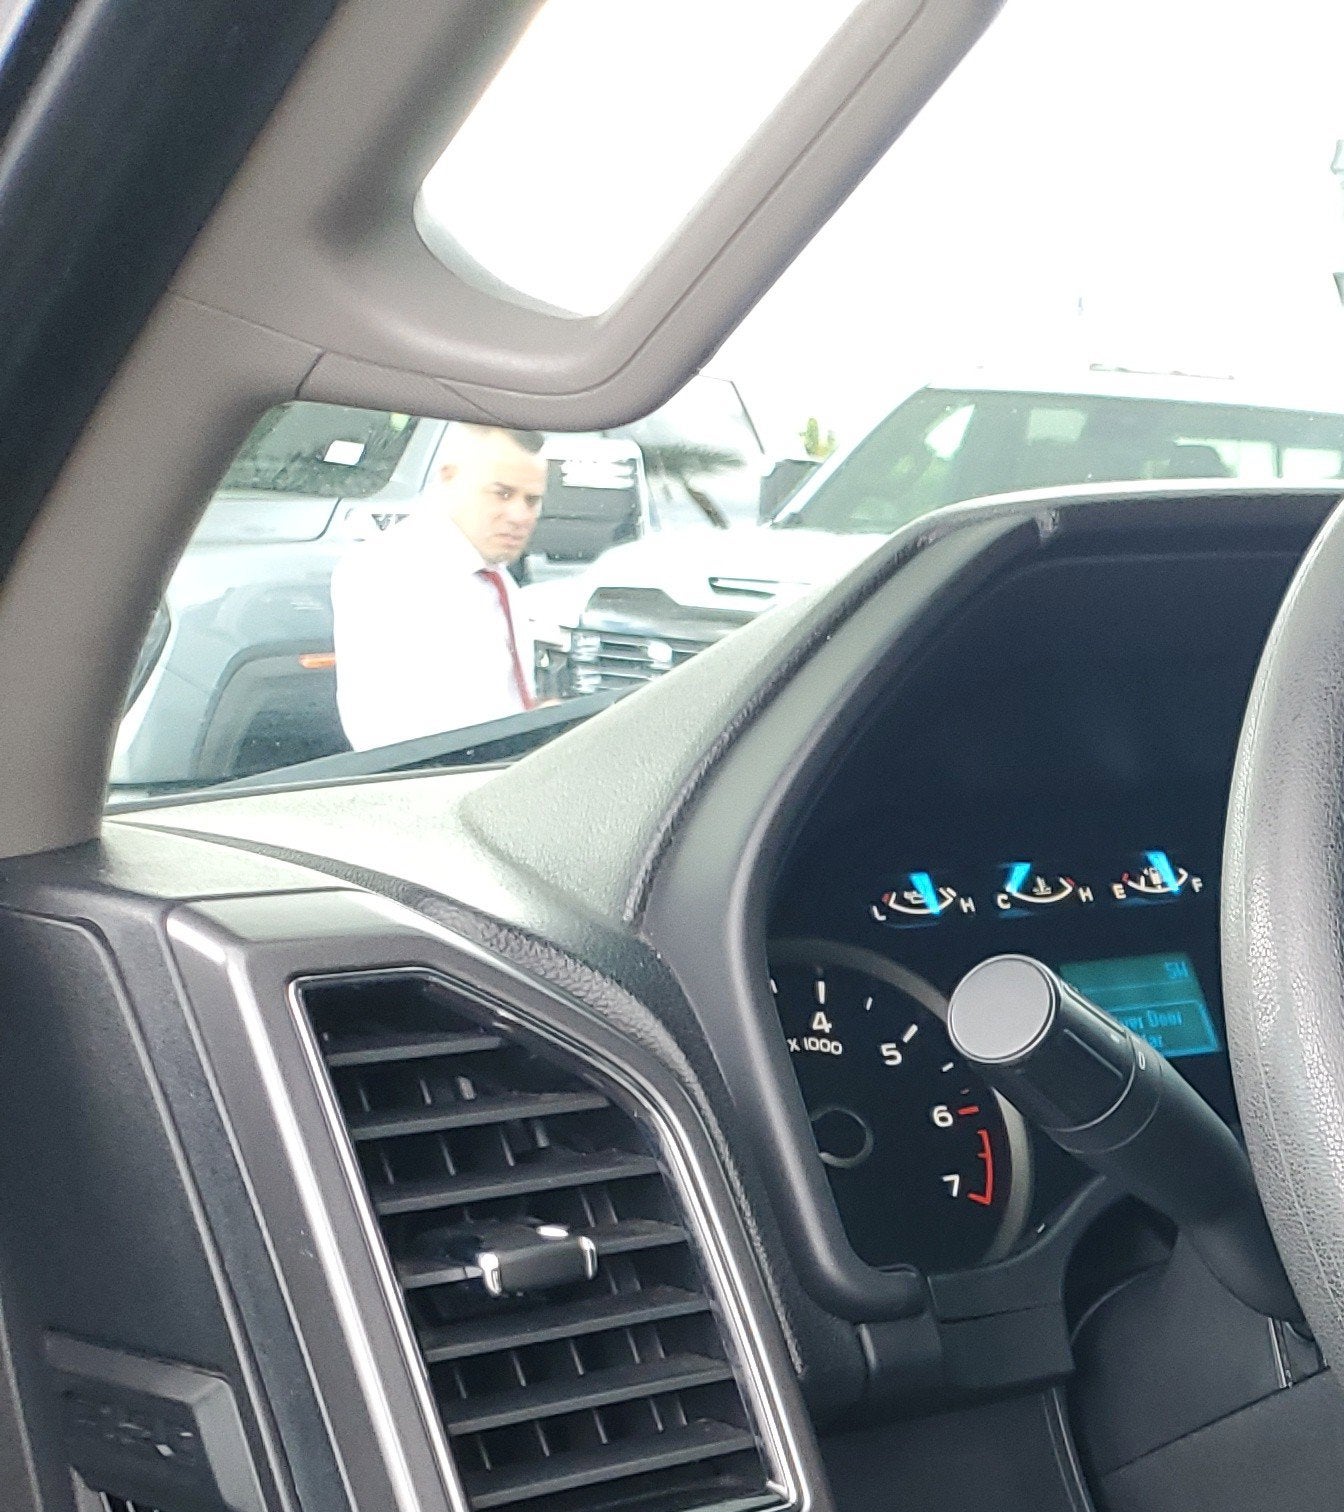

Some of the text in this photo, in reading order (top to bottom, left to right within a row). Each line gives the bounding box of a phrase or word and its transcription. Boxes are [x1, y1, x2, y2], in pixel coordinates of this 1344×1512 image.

[1079, 886, 1094, 902] H
[872, 906, 886, 922] L
[960, 898, 976, 913] H
[811, 1011, 832, 1034] 4
[788, 1038, 843, 1055] X 1000
[881, 1043, 902, 1066] 5
[933, 1105, 953, 1128] 6
[942, 1174, 961, 1197] 7
